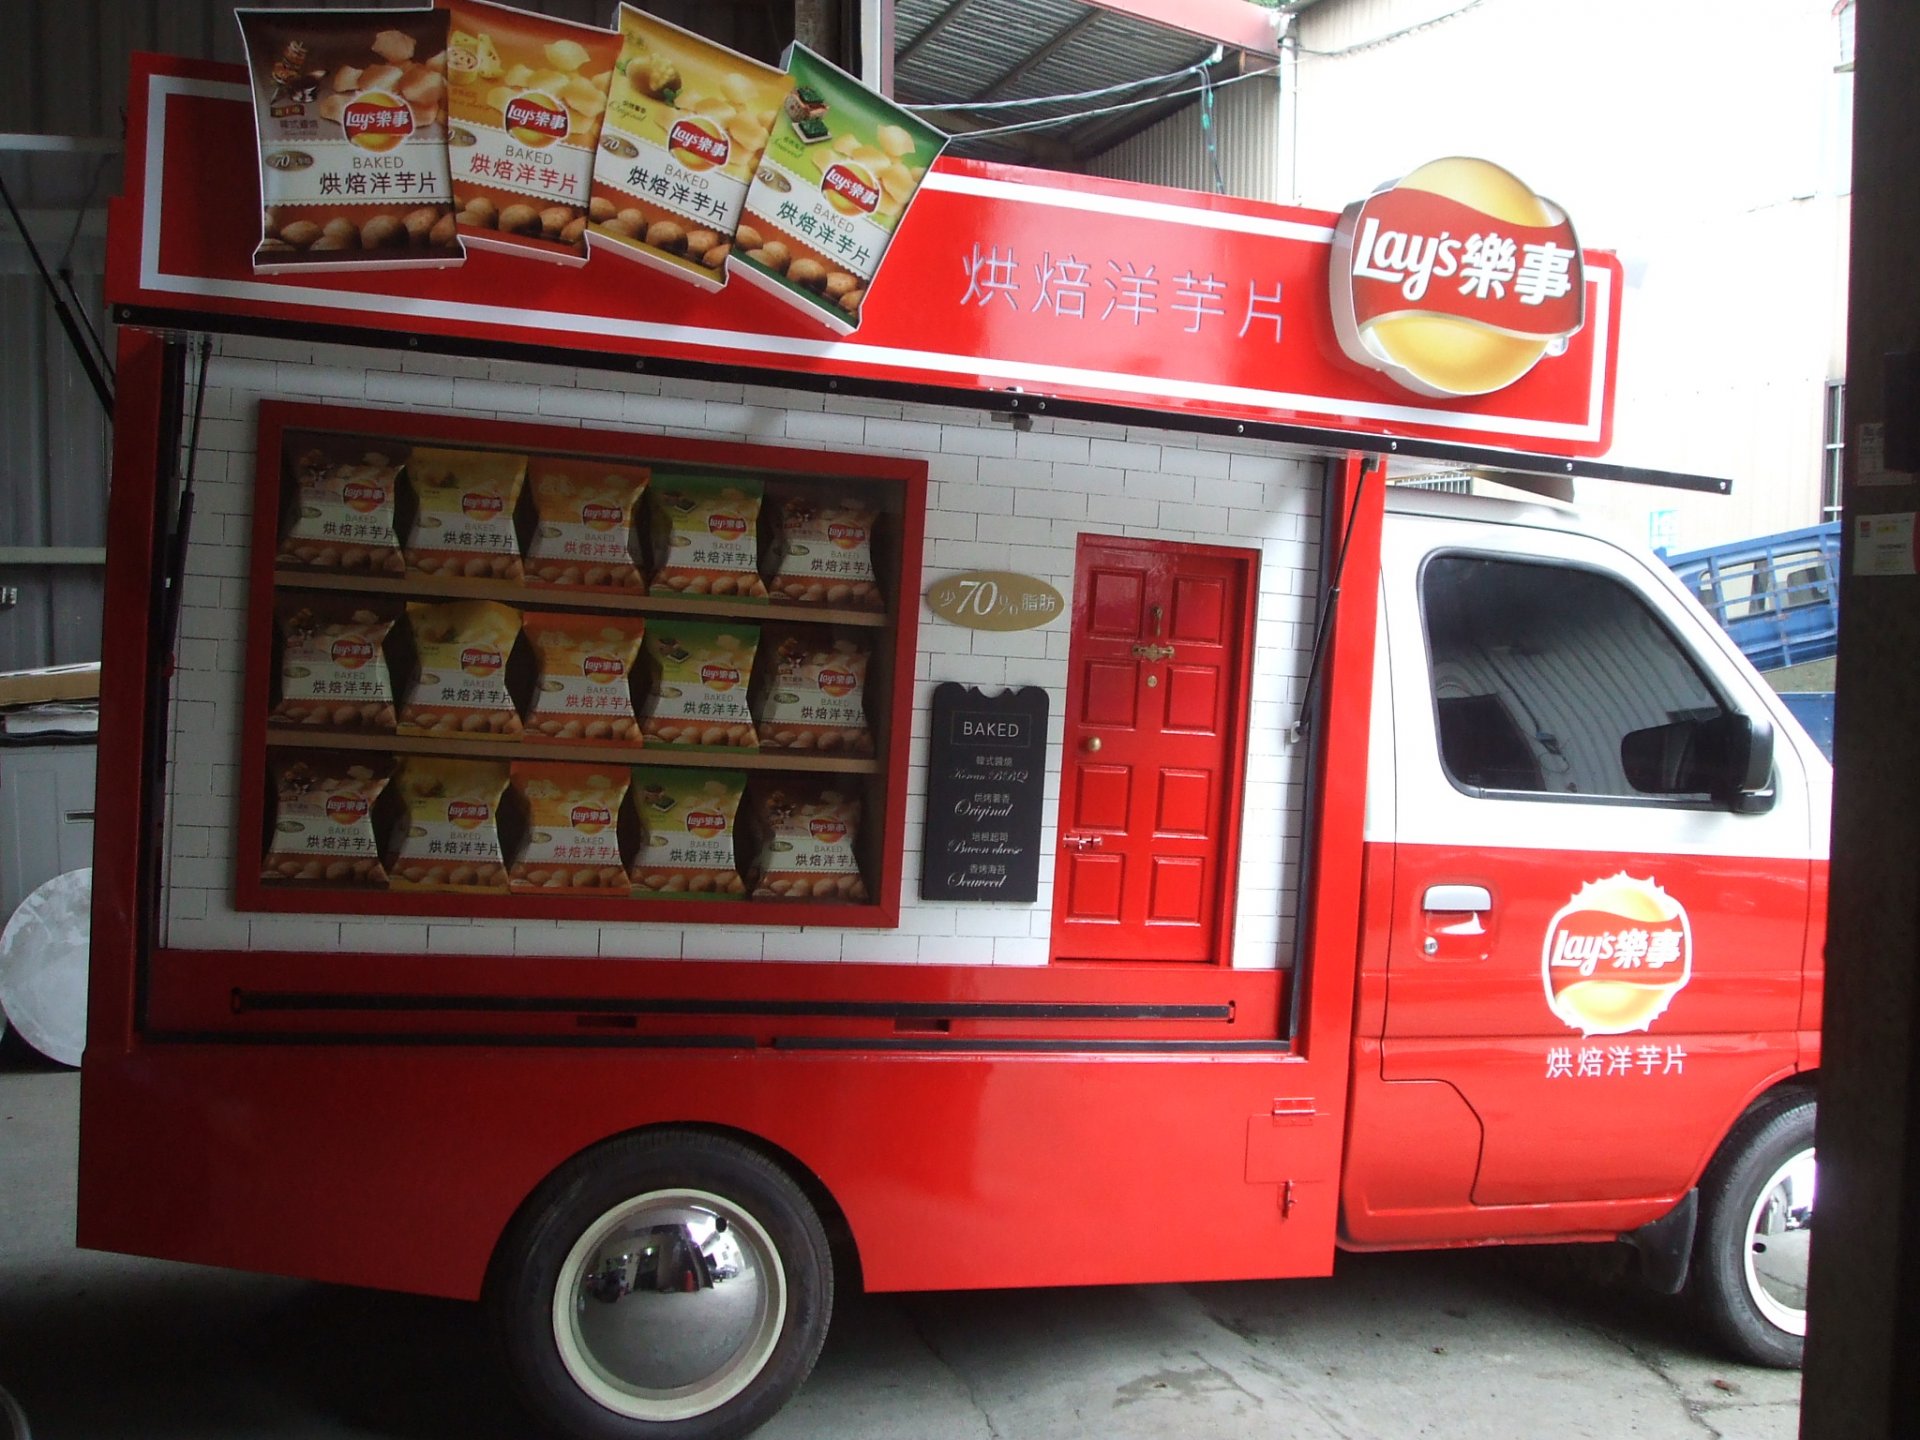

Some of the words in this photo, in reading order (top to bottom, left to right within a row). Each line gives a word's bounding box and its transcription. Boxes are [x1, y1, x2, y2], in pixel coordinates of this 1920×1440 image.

[353, 156, 404, 169] BAKED
[505, 144, 553, 166] BAKED
[319, 171, 437, 195] 烘焙洋芋片
[469, 152, 578, 195] 烘焙洋芋片
[665, 163, 710, 191] BAKED
[626, 165, 729, 221] 烘焙洋芋片
[812, 202, 855, 234] BAKED
[776, 200, 871, 267] 烘焙洋芋片
[960, 241, 1284, 343] 烘焙洋芋片
[323, 521, 394, 540] 烘焙洋芋片
[443, 531, 513, 548] 烘焙洋芋片
[312, 680, 384, 696] 烘焙洋芋片
[441, 687, 512, 704] 烘焙洋芋片
[683, 701, 750, 717] 烘焙洋芋片
[963, 721, 1019, 738] BAKED
[954, 799, 1013, 822] Original
[428, 839, 500, 855] 烘焙洋芋片
[948, 872, 1007, 889] Seaweed
[1545, 1044, 1687, 1079] 烘焙洋芋片
